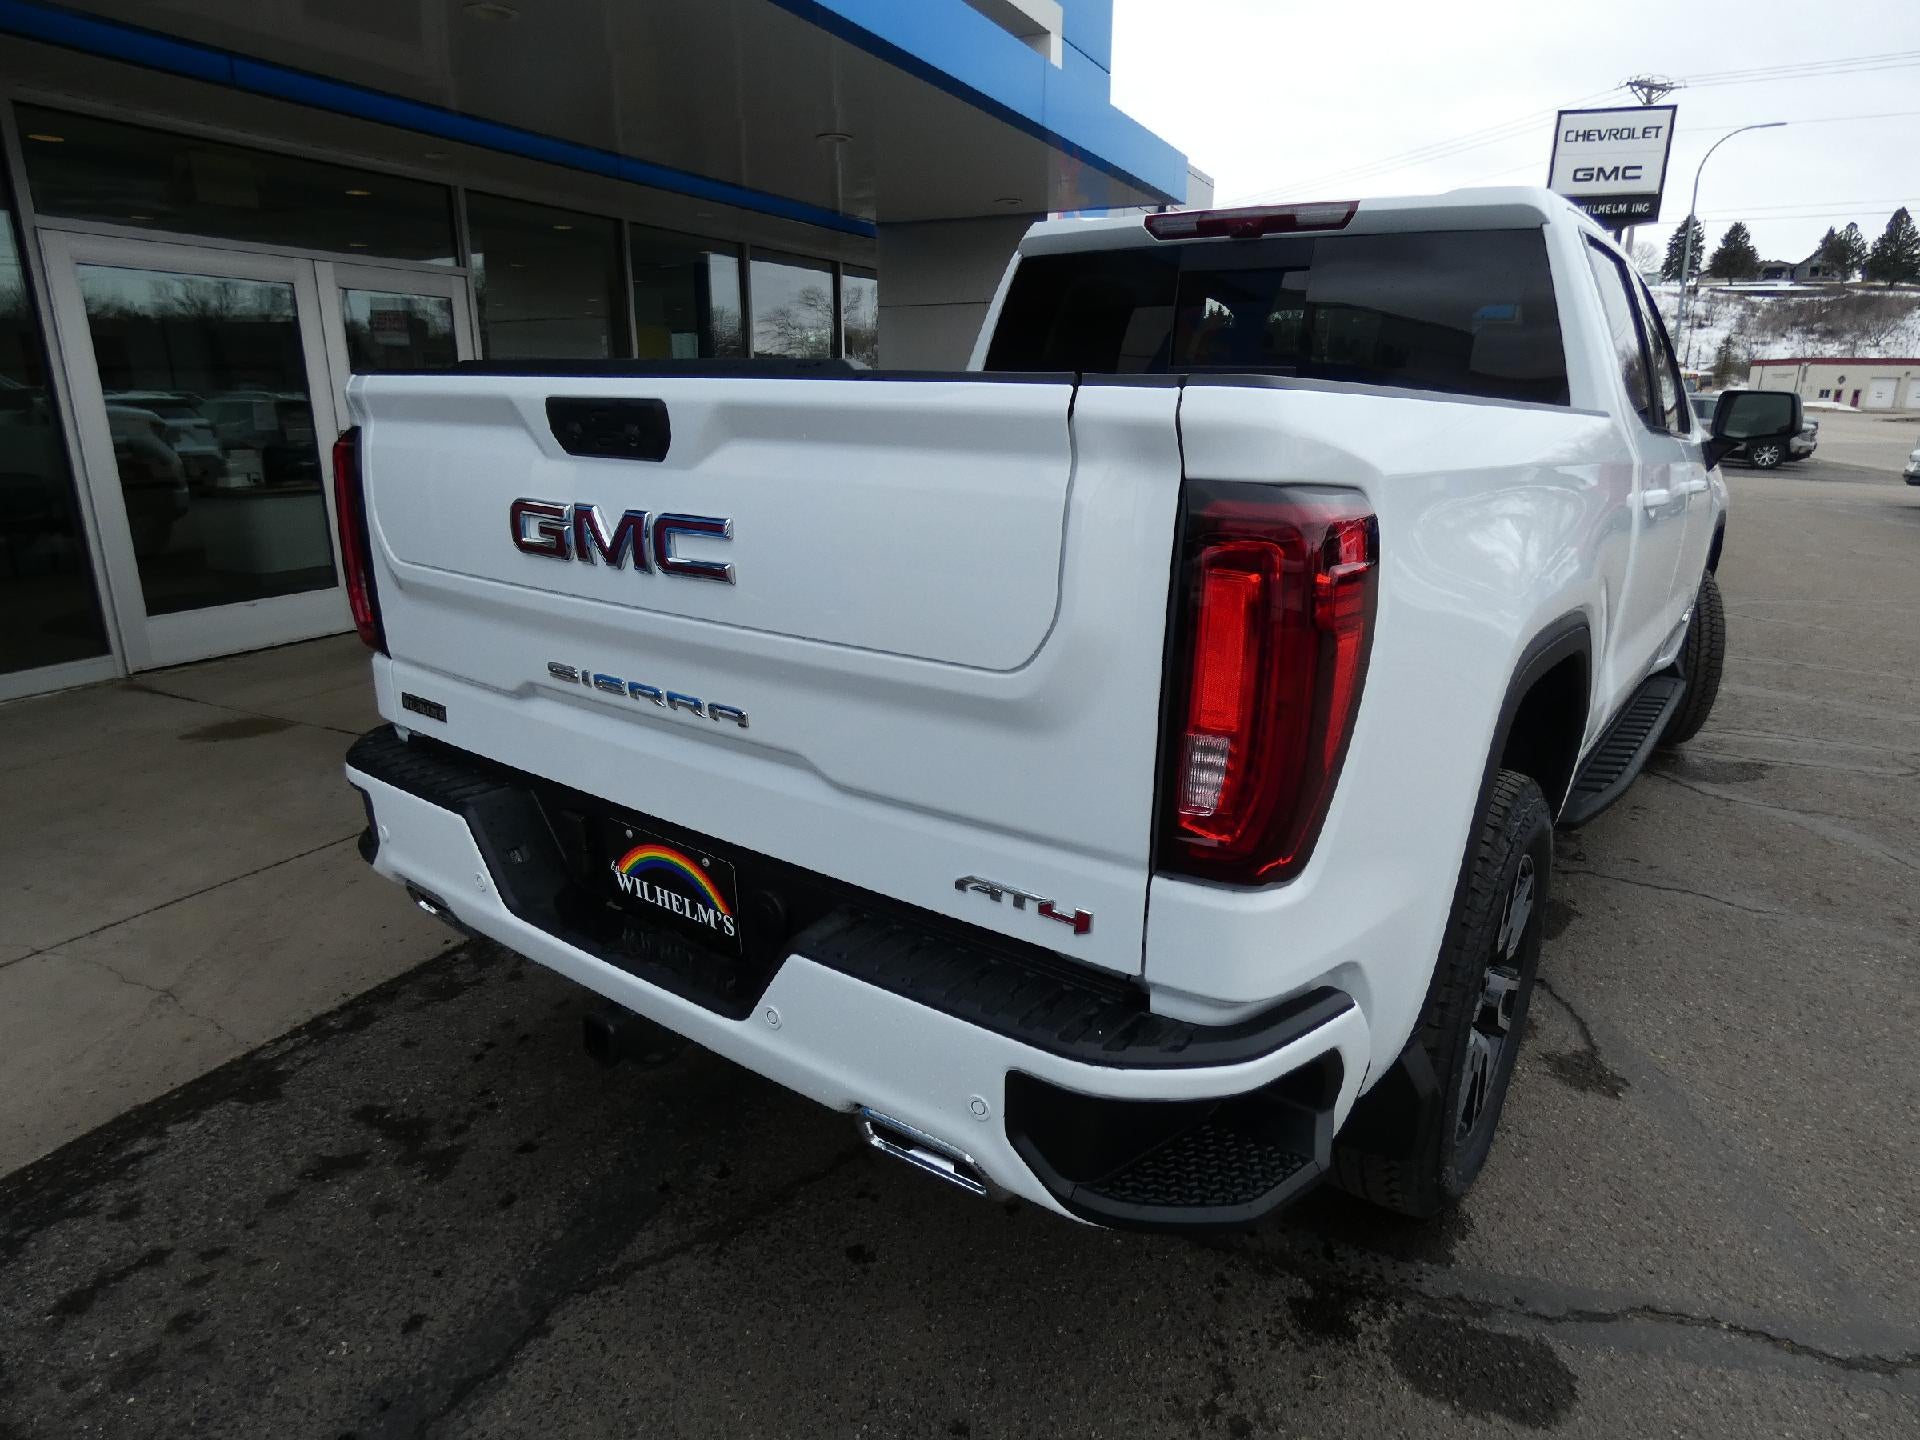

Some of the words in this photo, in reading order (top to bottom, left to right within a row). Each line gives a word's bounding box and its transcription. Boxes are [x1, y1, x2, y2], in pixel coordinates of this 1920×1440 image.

[1564, 125, 1663, 143] CHEVROLET
[1572, 165, 1643, 183] GMC
[1631, 202, 1650, 213] INC
[510, 497, 736, 585] GMC
[547, 661, 750, 729] SIERRA
[616, 871, 735, 937] WILHELM'S
[954, 875, 1095, 935] AT4
